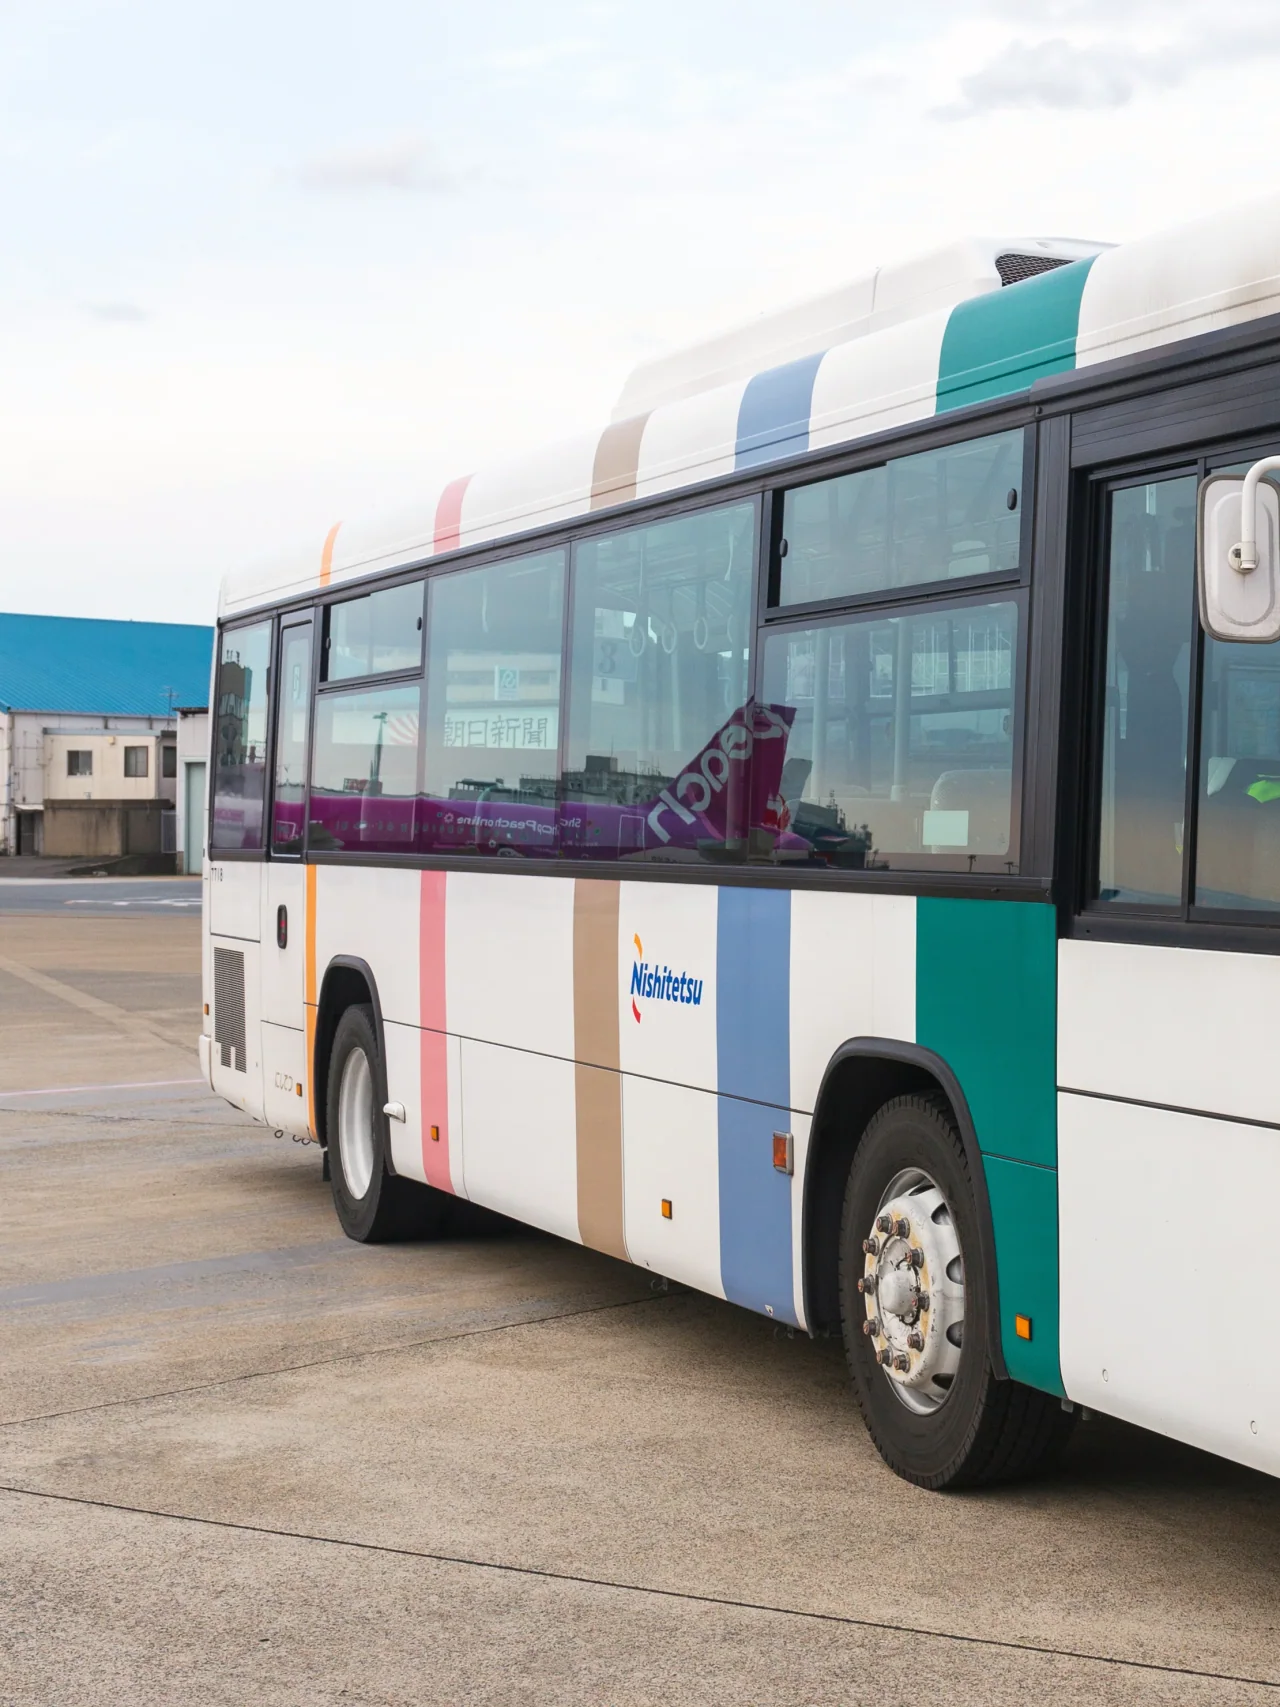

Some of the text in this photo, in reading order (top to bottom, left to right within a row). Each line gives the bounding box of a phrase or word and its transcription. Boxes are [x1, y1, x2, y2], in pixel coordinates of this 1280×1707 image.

[445, 714, 549, 749] 朝日新聞
[630, 960, 703, 1006] Nishitetsu
